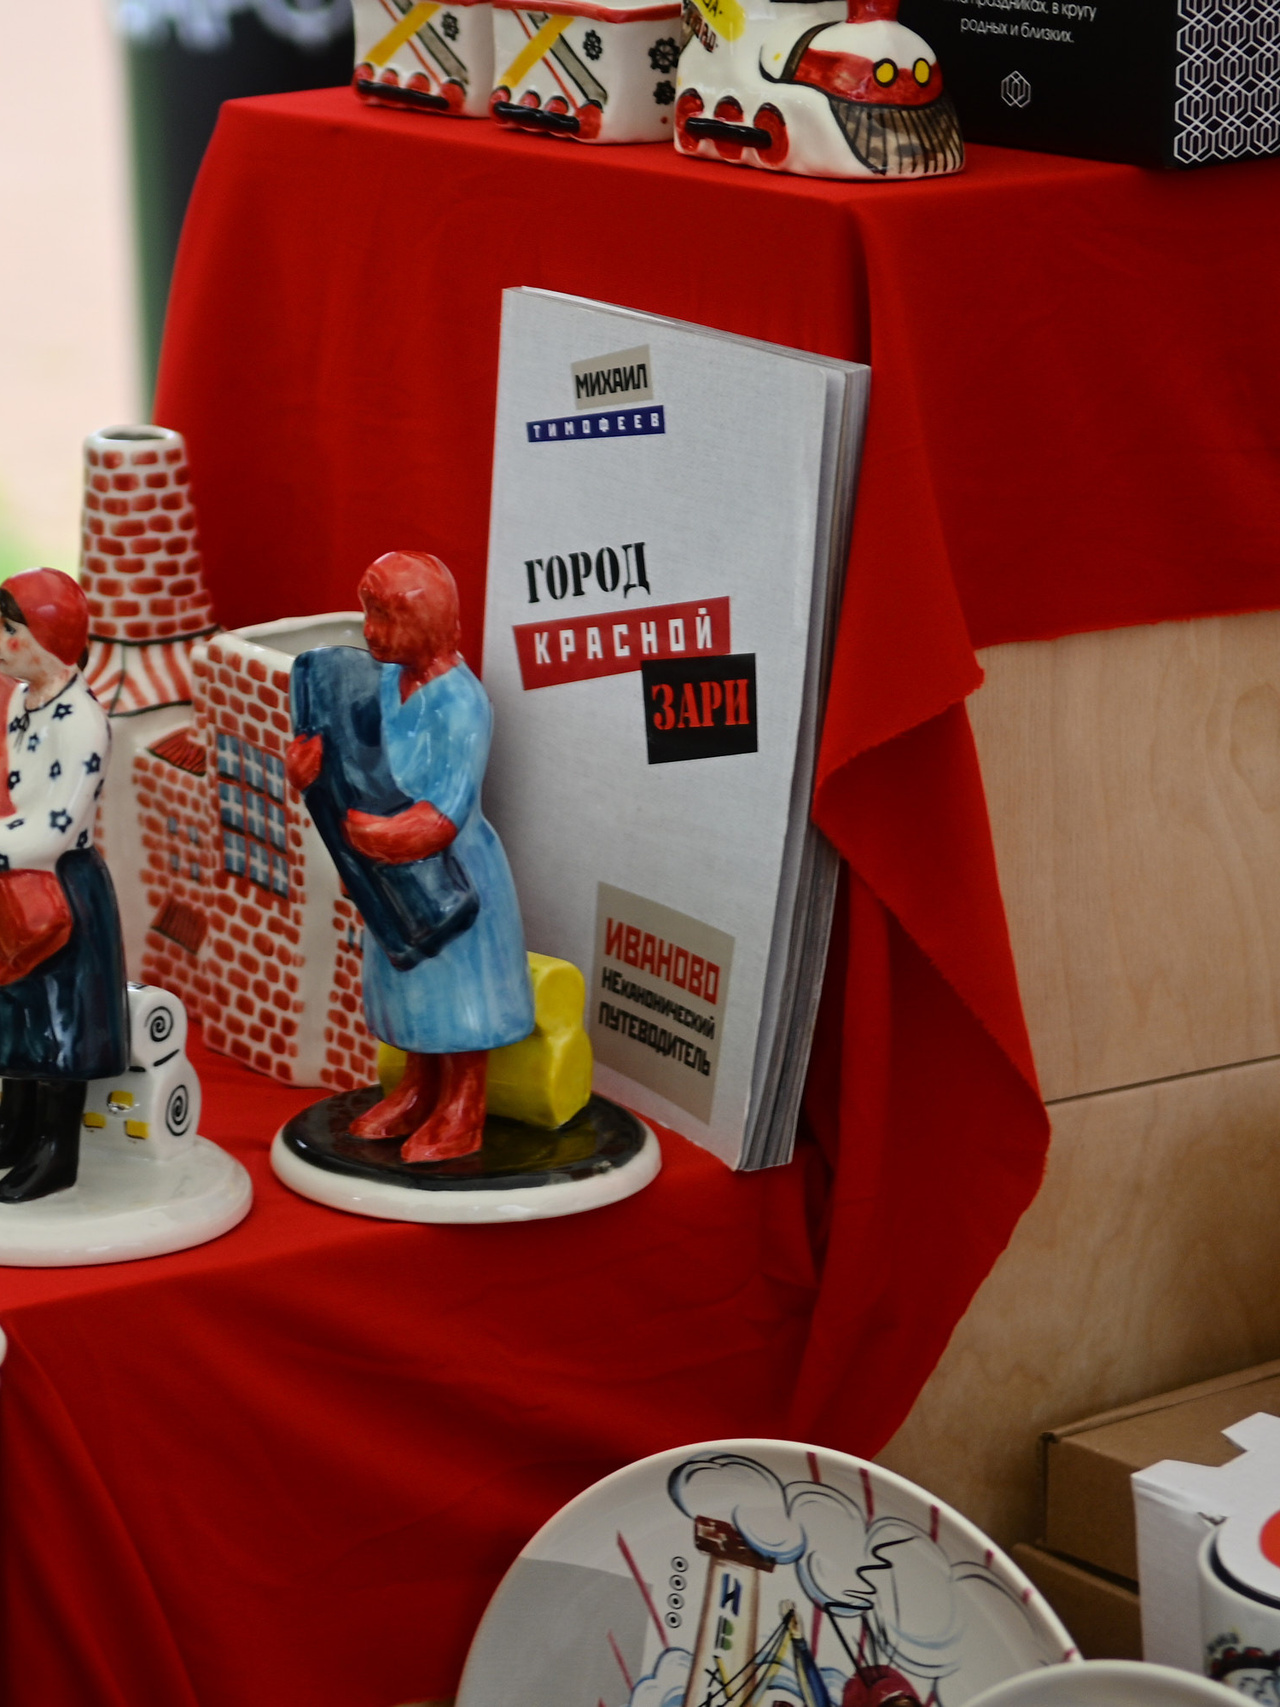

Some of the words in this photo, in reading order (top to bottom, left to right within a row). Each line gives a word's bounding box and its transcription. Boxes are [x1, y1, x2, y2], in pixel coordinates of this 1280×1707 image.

[960, 18, 1007, 34] родных
[1010, 24, 1018, 36] и
[1021, 22, 1074, 43] близких.
[970, 0, 1048, 14] раздниках,
[1052, 2, 1059, 14] в
[1062, 4, 1097, 21] кругу
[575, 363, 648, 399] МИХАИЛ
[532, 412, 660, 439] ТИМОФЕЕВ
[524, 541, 651, 604] ГОРОД
[534, 607, 713, 664] КРАСНОЙ
[651, 678, 750, 731] ЗАРИ
[604, 917, 721, 1006] ИВАНОВО
[601, 966, 716, 1041] НЕКАНОНИЧЕСКИЙ
[598, 1001, 711, 1077] ПУТЕВОДИТЕЛЬ
